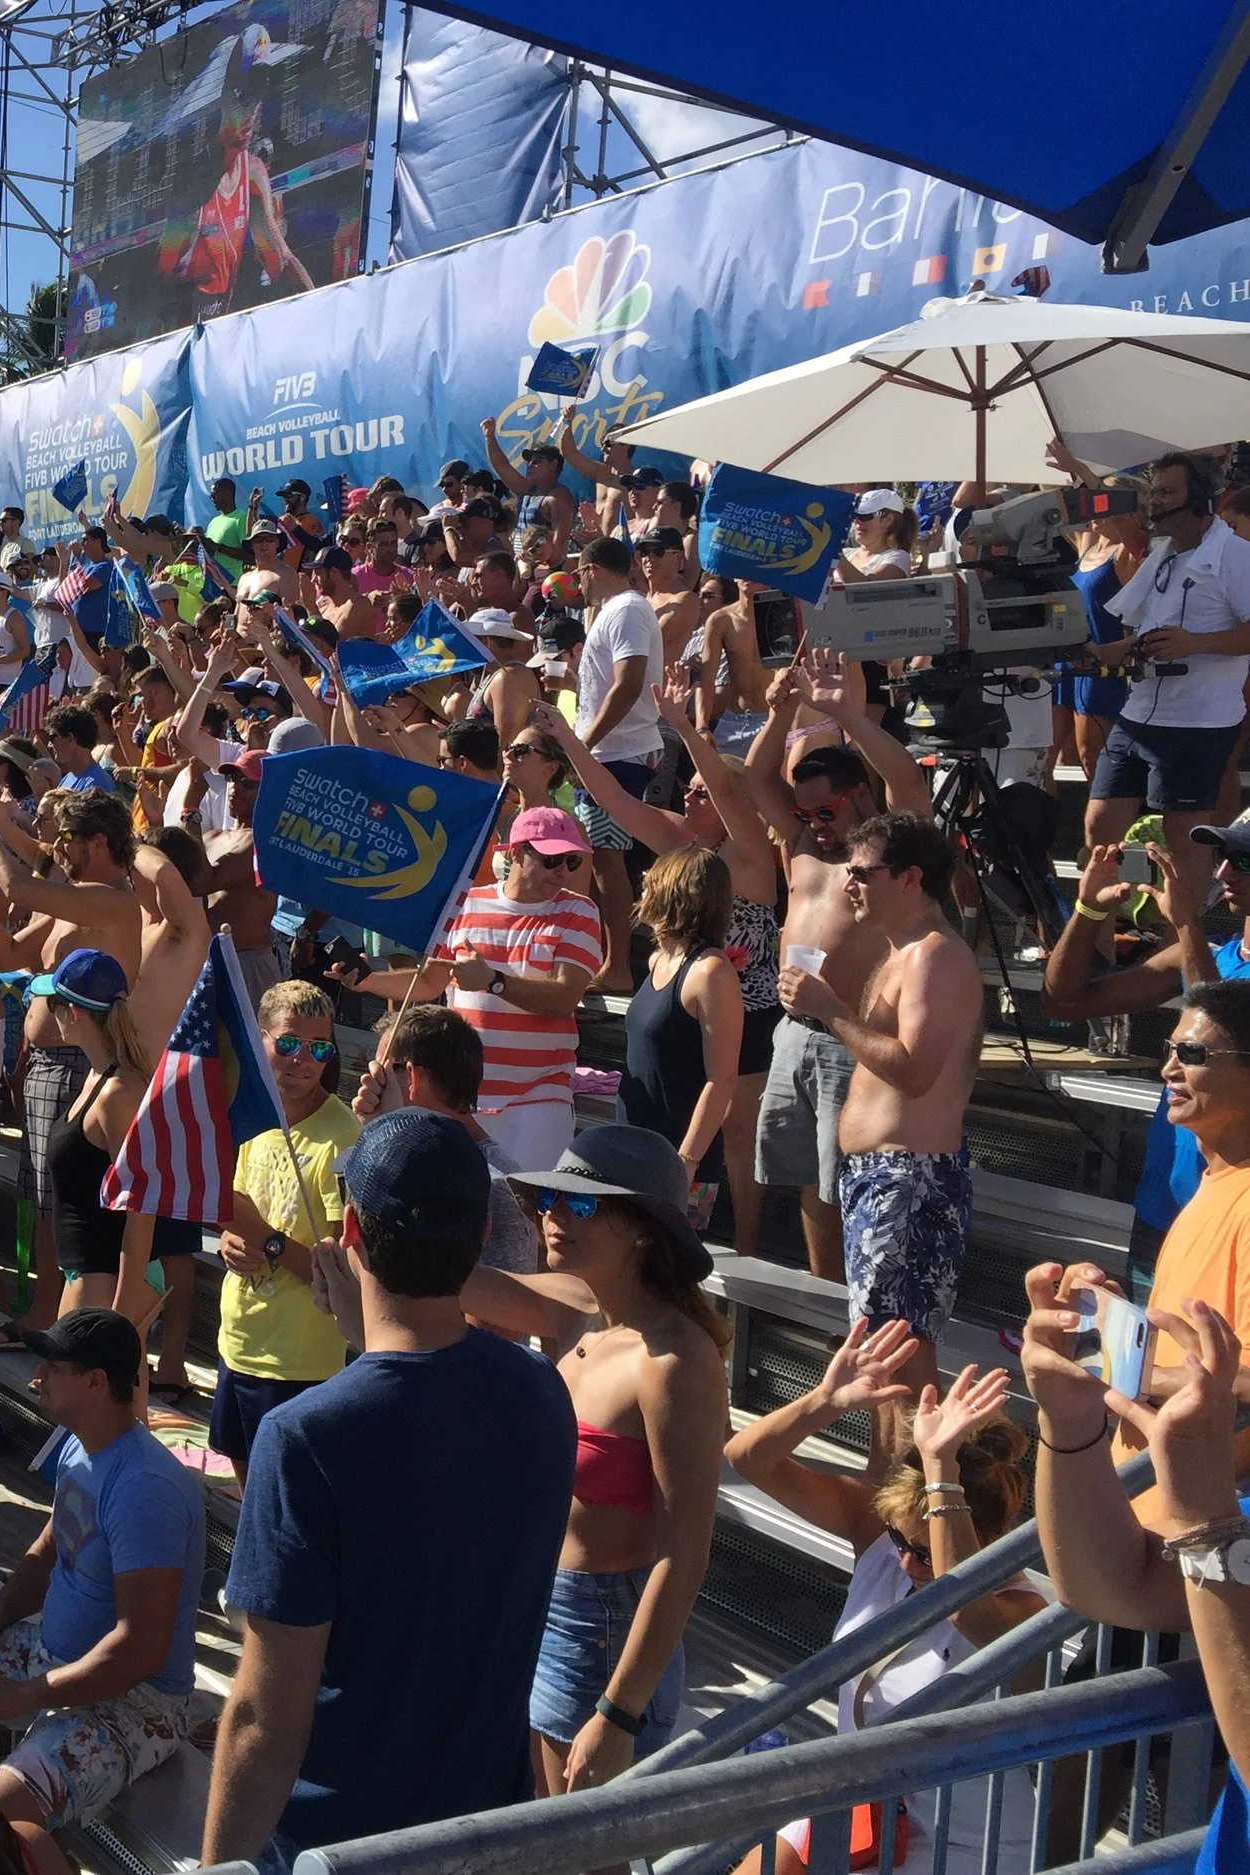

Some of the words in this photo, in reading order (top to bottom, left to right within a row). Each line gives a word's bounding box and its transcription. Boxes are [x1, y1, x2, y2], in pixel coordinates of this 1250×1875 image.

[273, 371, 317, 404] FIVB
[28, 414, 92, 452] swatch
[246, 424, 276, 440] BEACH
[278, 408, 340, 432] VOLLEYBALL
[26, 450, 56, 470] BEACH
[59, 434, 122, 462] VOLLEYBALL
[201, 434, 304, 481] WORLD
[309, 414, 405, 460] TOUR
[25, 469, 48, 490] FIVB
[94, 451, 128, 474] TOUR
[724, 502, 782, 525] swatch
[712, 526, 796, 558] FINALS
[740, 524, 778, 541] WORLD
[780, 535, 808, 547] TOUR
[293, 768, 369, 813] swatch
[285, 797, 306, 814] FIVB
[306, 807, 362, 839] WORLD
[366, 831, 408, 859] TOUR
[289, 785, 319, 805] BEACH
[322, 799, 404, 844] VOLLEYBALL
[273, 811, 389, 874] FINALS
